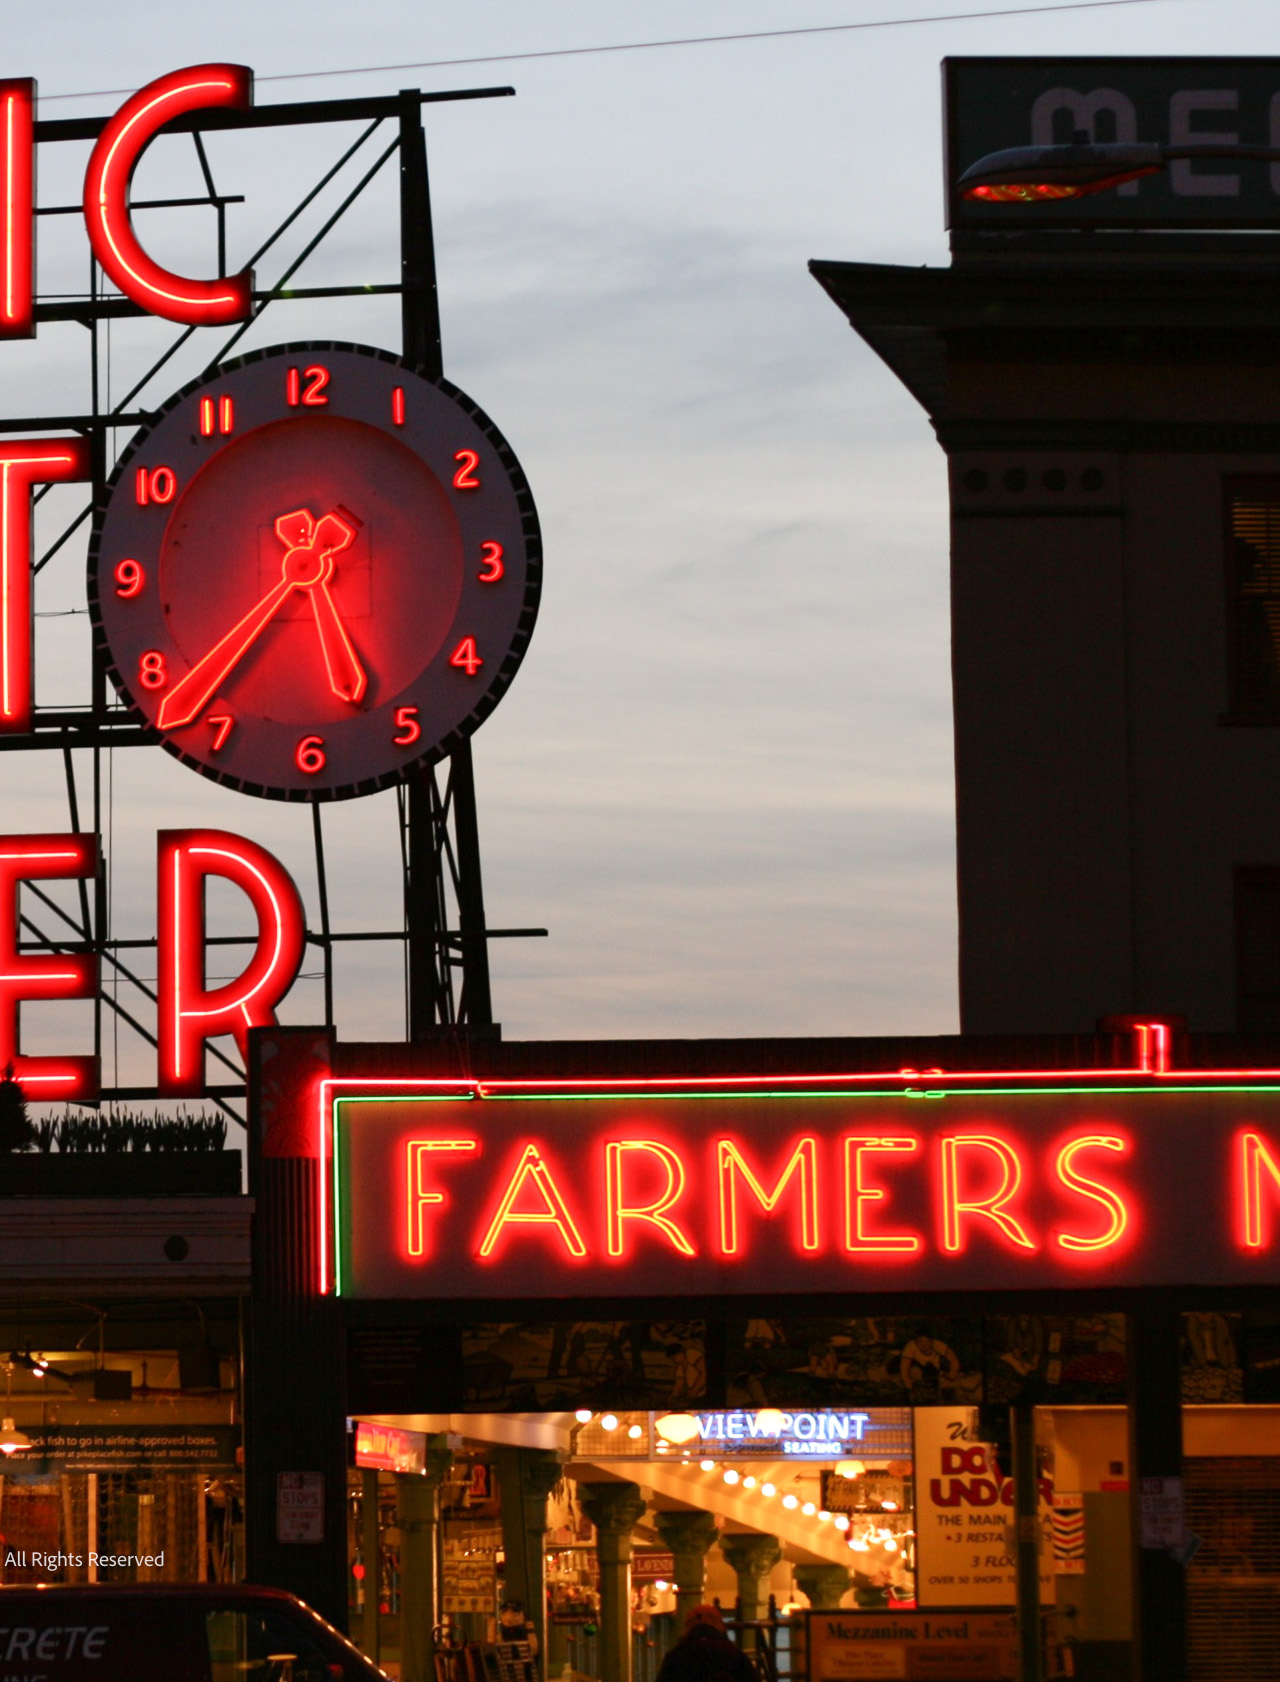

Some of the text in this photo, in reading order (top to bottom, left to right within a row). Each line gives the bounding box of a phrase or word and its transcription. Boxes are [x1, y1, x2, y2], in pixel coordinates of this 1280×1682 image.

[1030, 86, 1280, 197] ME
[286, 364, 332, 408] 12
[391, 385, 406, 426] 1
[199, 394, 234, 437] 11
[135, 465, 178, 506] 10
[452, 448, 481, 490] 2
[114, 558, 146, 599] 9
[478, 540, 505, 583] 3
[138, 649, 168, 690] 8
[448, 634, 484, 677] 4
[206, 714, 235, 753] 7
[393, 705, 423, 747] 5
[295, 735, 326, 775] 6
[399, 1130, 1132, 1262] FARMERS
[29, 1434, 219, 1449] ack fish to go in airline-approved boxes.
[783, 1440, 842, 1454] SEATING
[1142, 1479, 1161, 1493] NO
[936, 1514, 1008, 1526] THE MAIN
[954, 1532, 962, 1543] 3
[928, 1575, 955, 1585] OVER
[973, 1575, 1003, 1584] SHOPS
[971, 1555, 980, 1567] 3
[827, 1621, 918, 1640] Mezzanine
[924, 1621, 969, 1640] Level
